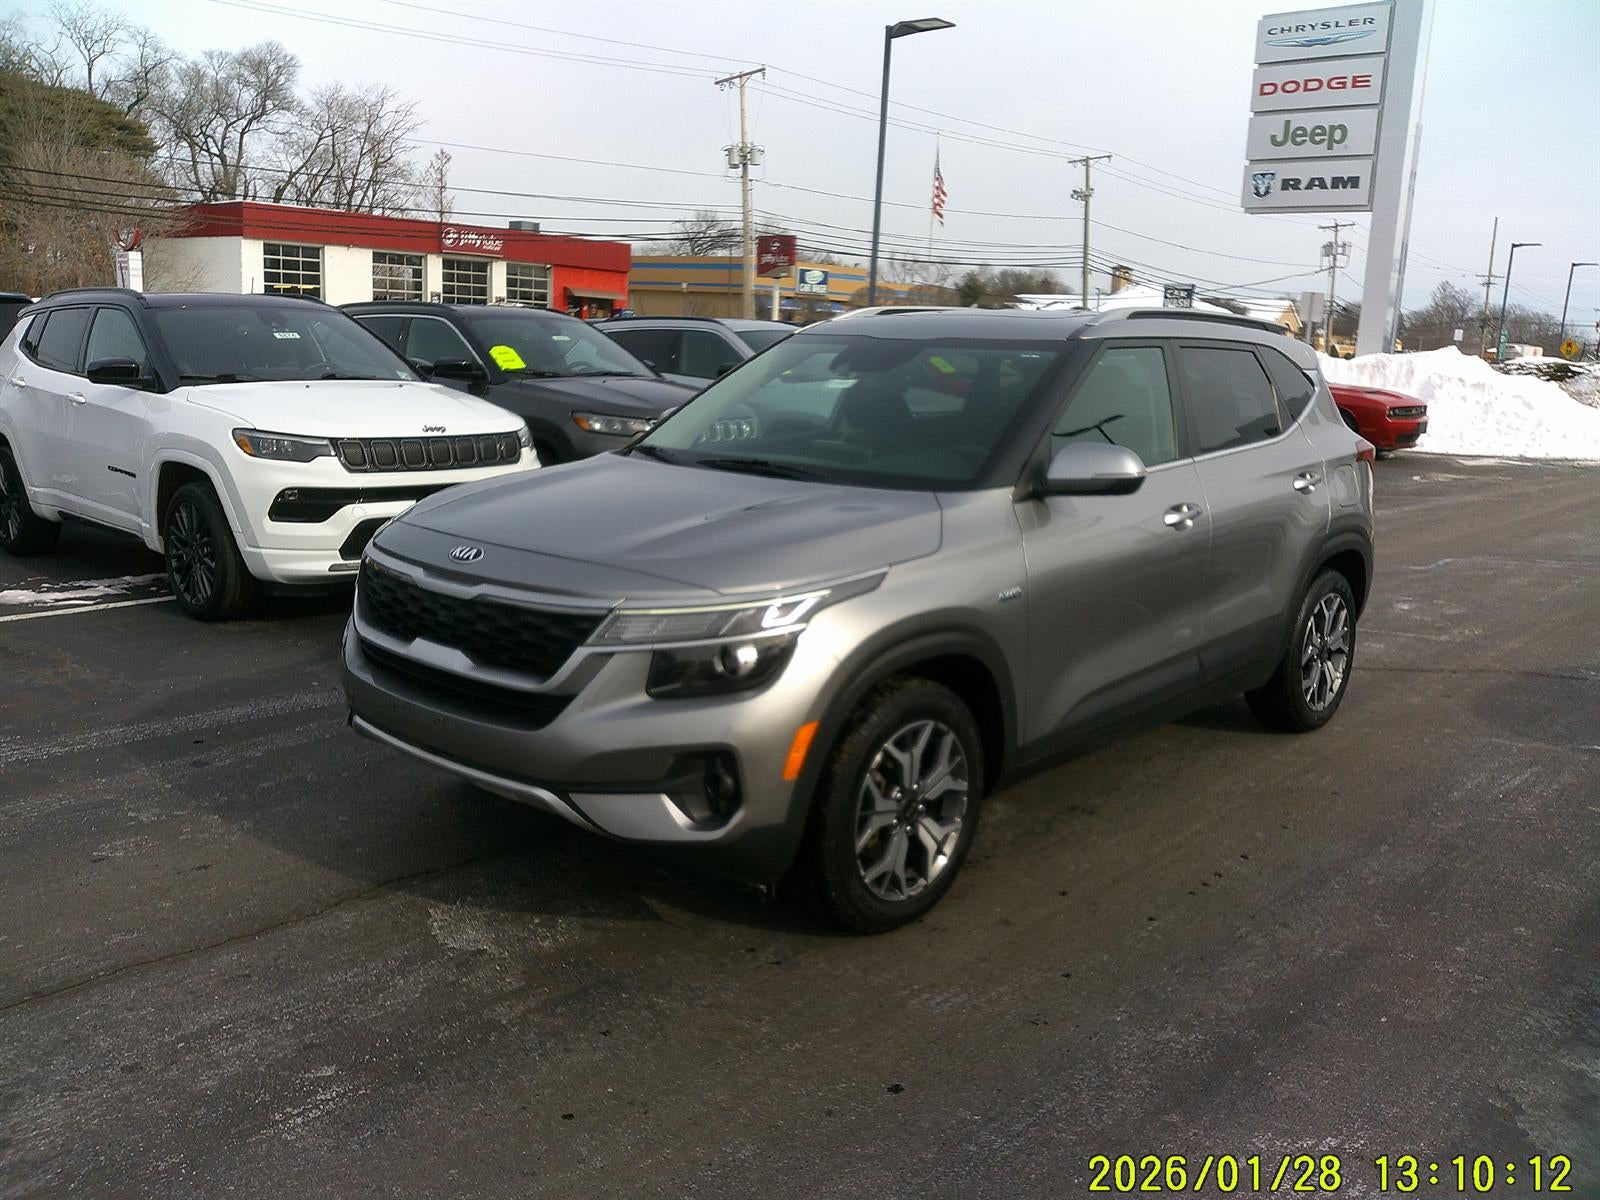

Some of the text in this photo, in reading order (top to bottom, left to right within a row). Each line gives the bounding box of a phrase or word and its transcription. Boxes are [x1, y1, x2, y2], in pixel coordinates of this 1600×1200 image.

[1267, 17, 1376, 36] CHRYSLER
[1258, 74, 1373, 97] DODGE
[1270, 119, 1348, 151] Jeep
[1280, 175, 1361, 191] RAM
